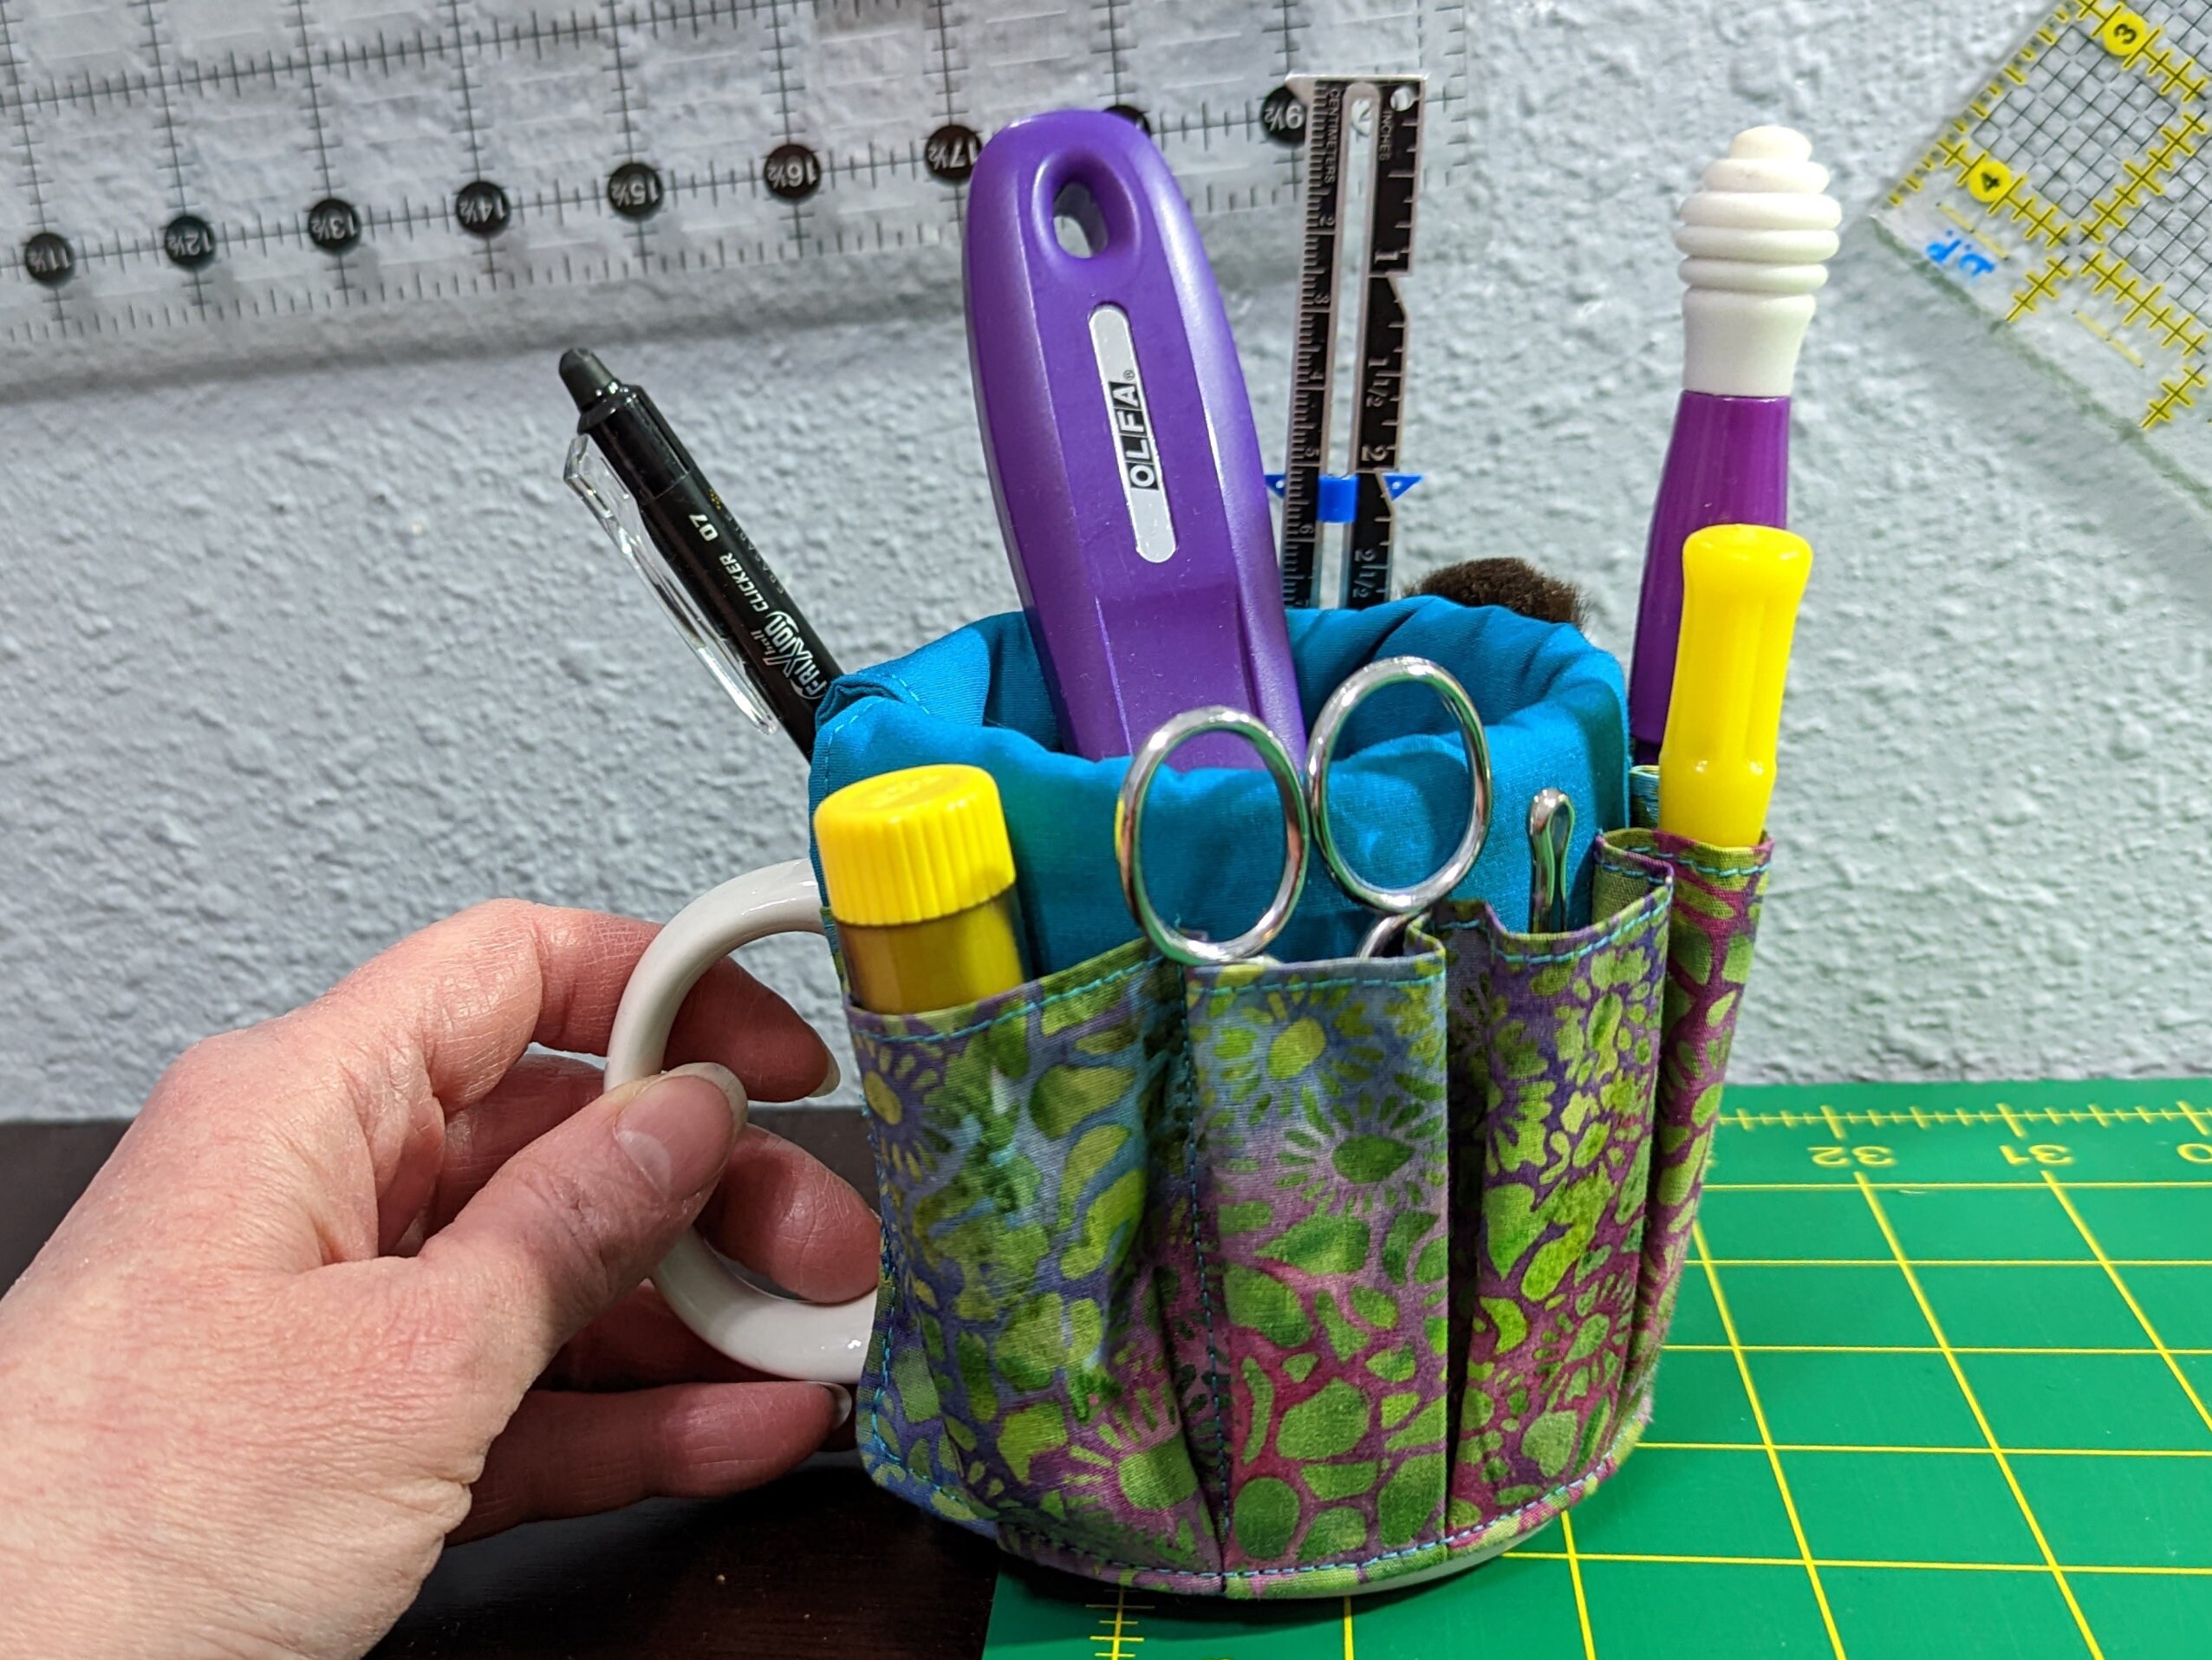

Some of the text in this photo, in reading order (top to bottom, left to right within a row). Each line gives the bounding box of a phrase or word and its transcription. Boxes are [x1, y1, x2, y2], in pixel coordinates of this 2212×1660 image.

[2113, 23, 2138, 45] 3
[1265, 105, 1304, 132] 9½
[1324, 88, 1340, 184] CENTIMETERS
[1379, 111, 1392, 161] INCHES
[928, 143, 978, 169] 17½
[767, 164, 816, 188] 16½
[1981, 173, 2001, 192] 4
[611, 181, 659, 205] 15½
[459, 199, 505, 223] 14½
[311, 216, 355, 239] 13½
[167, 233, 211, 256] 12½
[1361, 445, 1387, 462] 2
[719, 551, 770, 612] CLICKER
[751, 629, 772, 661] ball
[1807, 1144, 1898, 1167] 32
[1999, 1143, 2076, 1166] 31
[2176, 1142, 2212, 1163] 0
